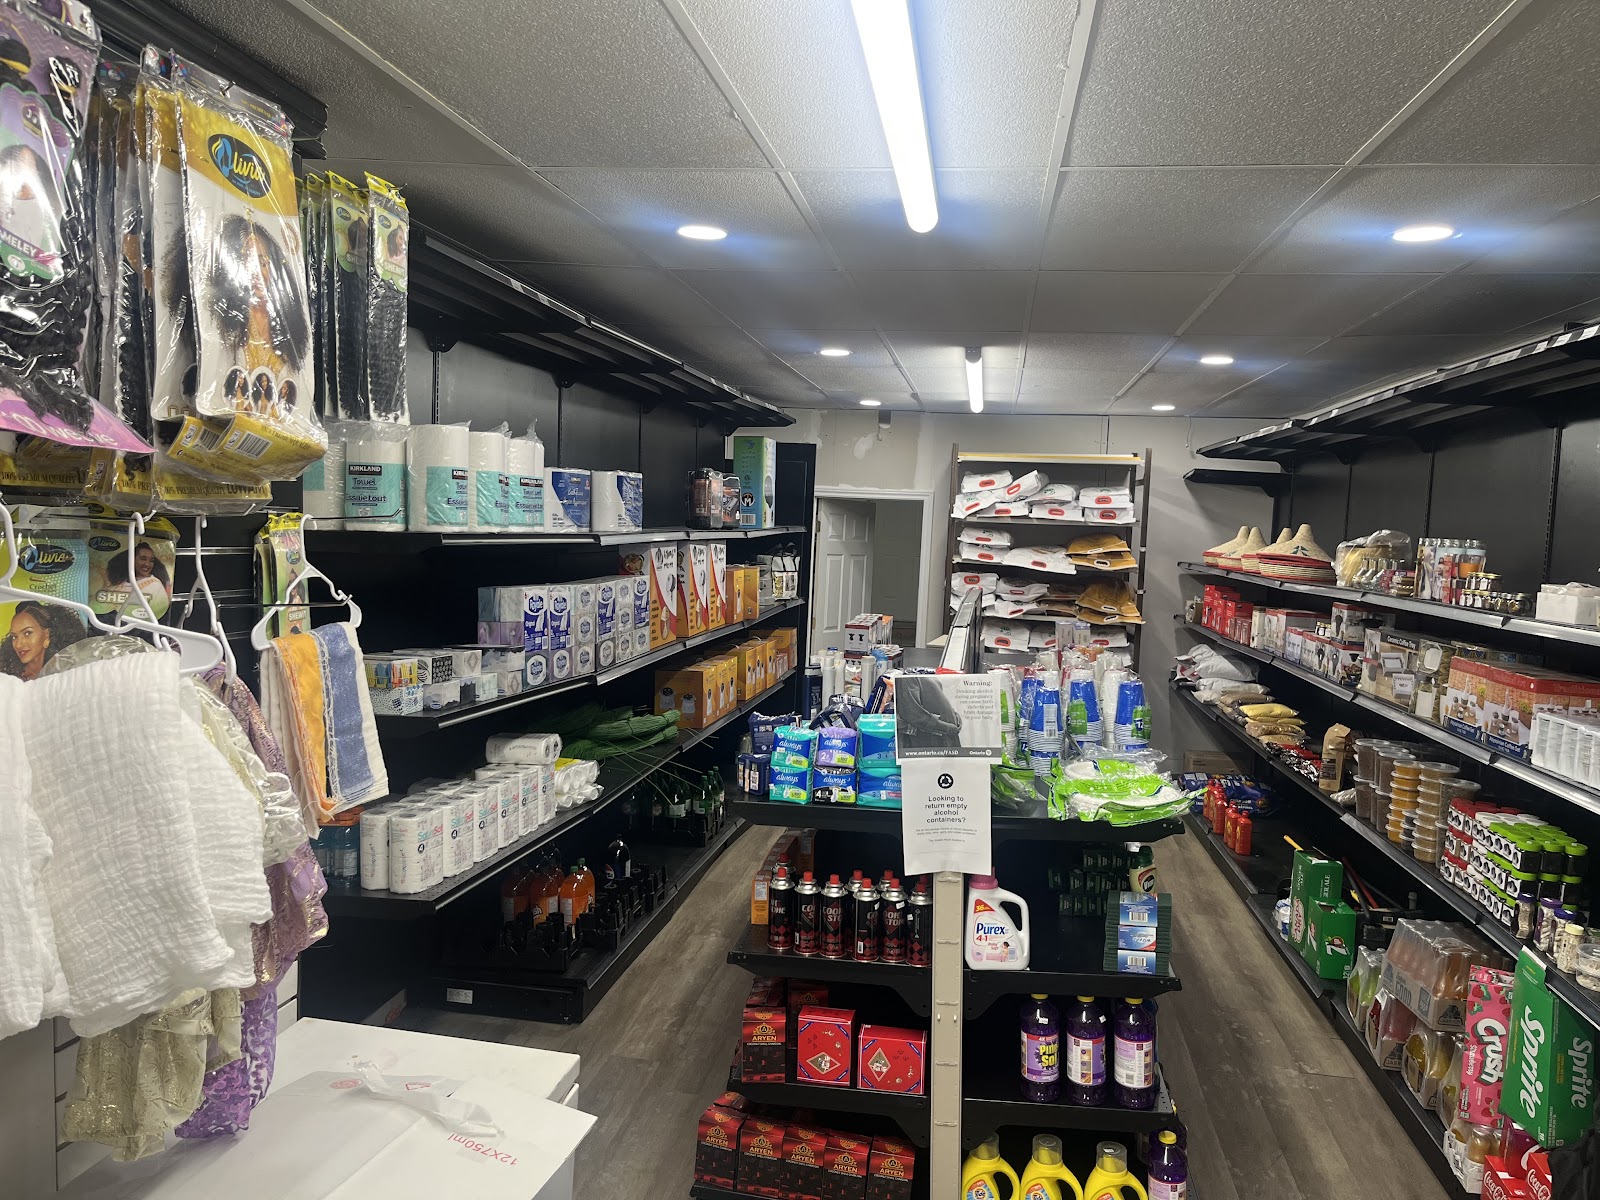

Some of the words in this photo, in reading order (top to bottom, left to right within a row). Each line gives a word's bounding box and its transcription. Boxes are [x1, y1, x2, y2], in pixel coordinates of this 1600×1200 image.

[349, 465, 381, 473] KIRKLAND
[29, 583, 57, 592] Crochet
[778, 740, 803, 752] always
[821, 752, 826, 760] 2
[775, 774, 799, 784] always
[823, 774, 847, 785] always
[928, 795, 956, 803] Looking
[946, 802, 968, 810] empty
[976, 922, 1006, 935] Purex
[1477, 1018, 1507, 1085] Crush
[1519, 1005, 1545, 1119] Sprite
[1567, 1036, 1594, 1109] Sprite
[706, 1135, 729, 1146] ARYEN
[447, 1133, 518, 1167] 12X750ml
[749, 1146, 773, 1156] ARYEN
[791, 1154, 815, 1164] ARYEN
[833, 1164, 858, 1173] ARYEN
[880, 1168, 904, 1177] ARYEN
